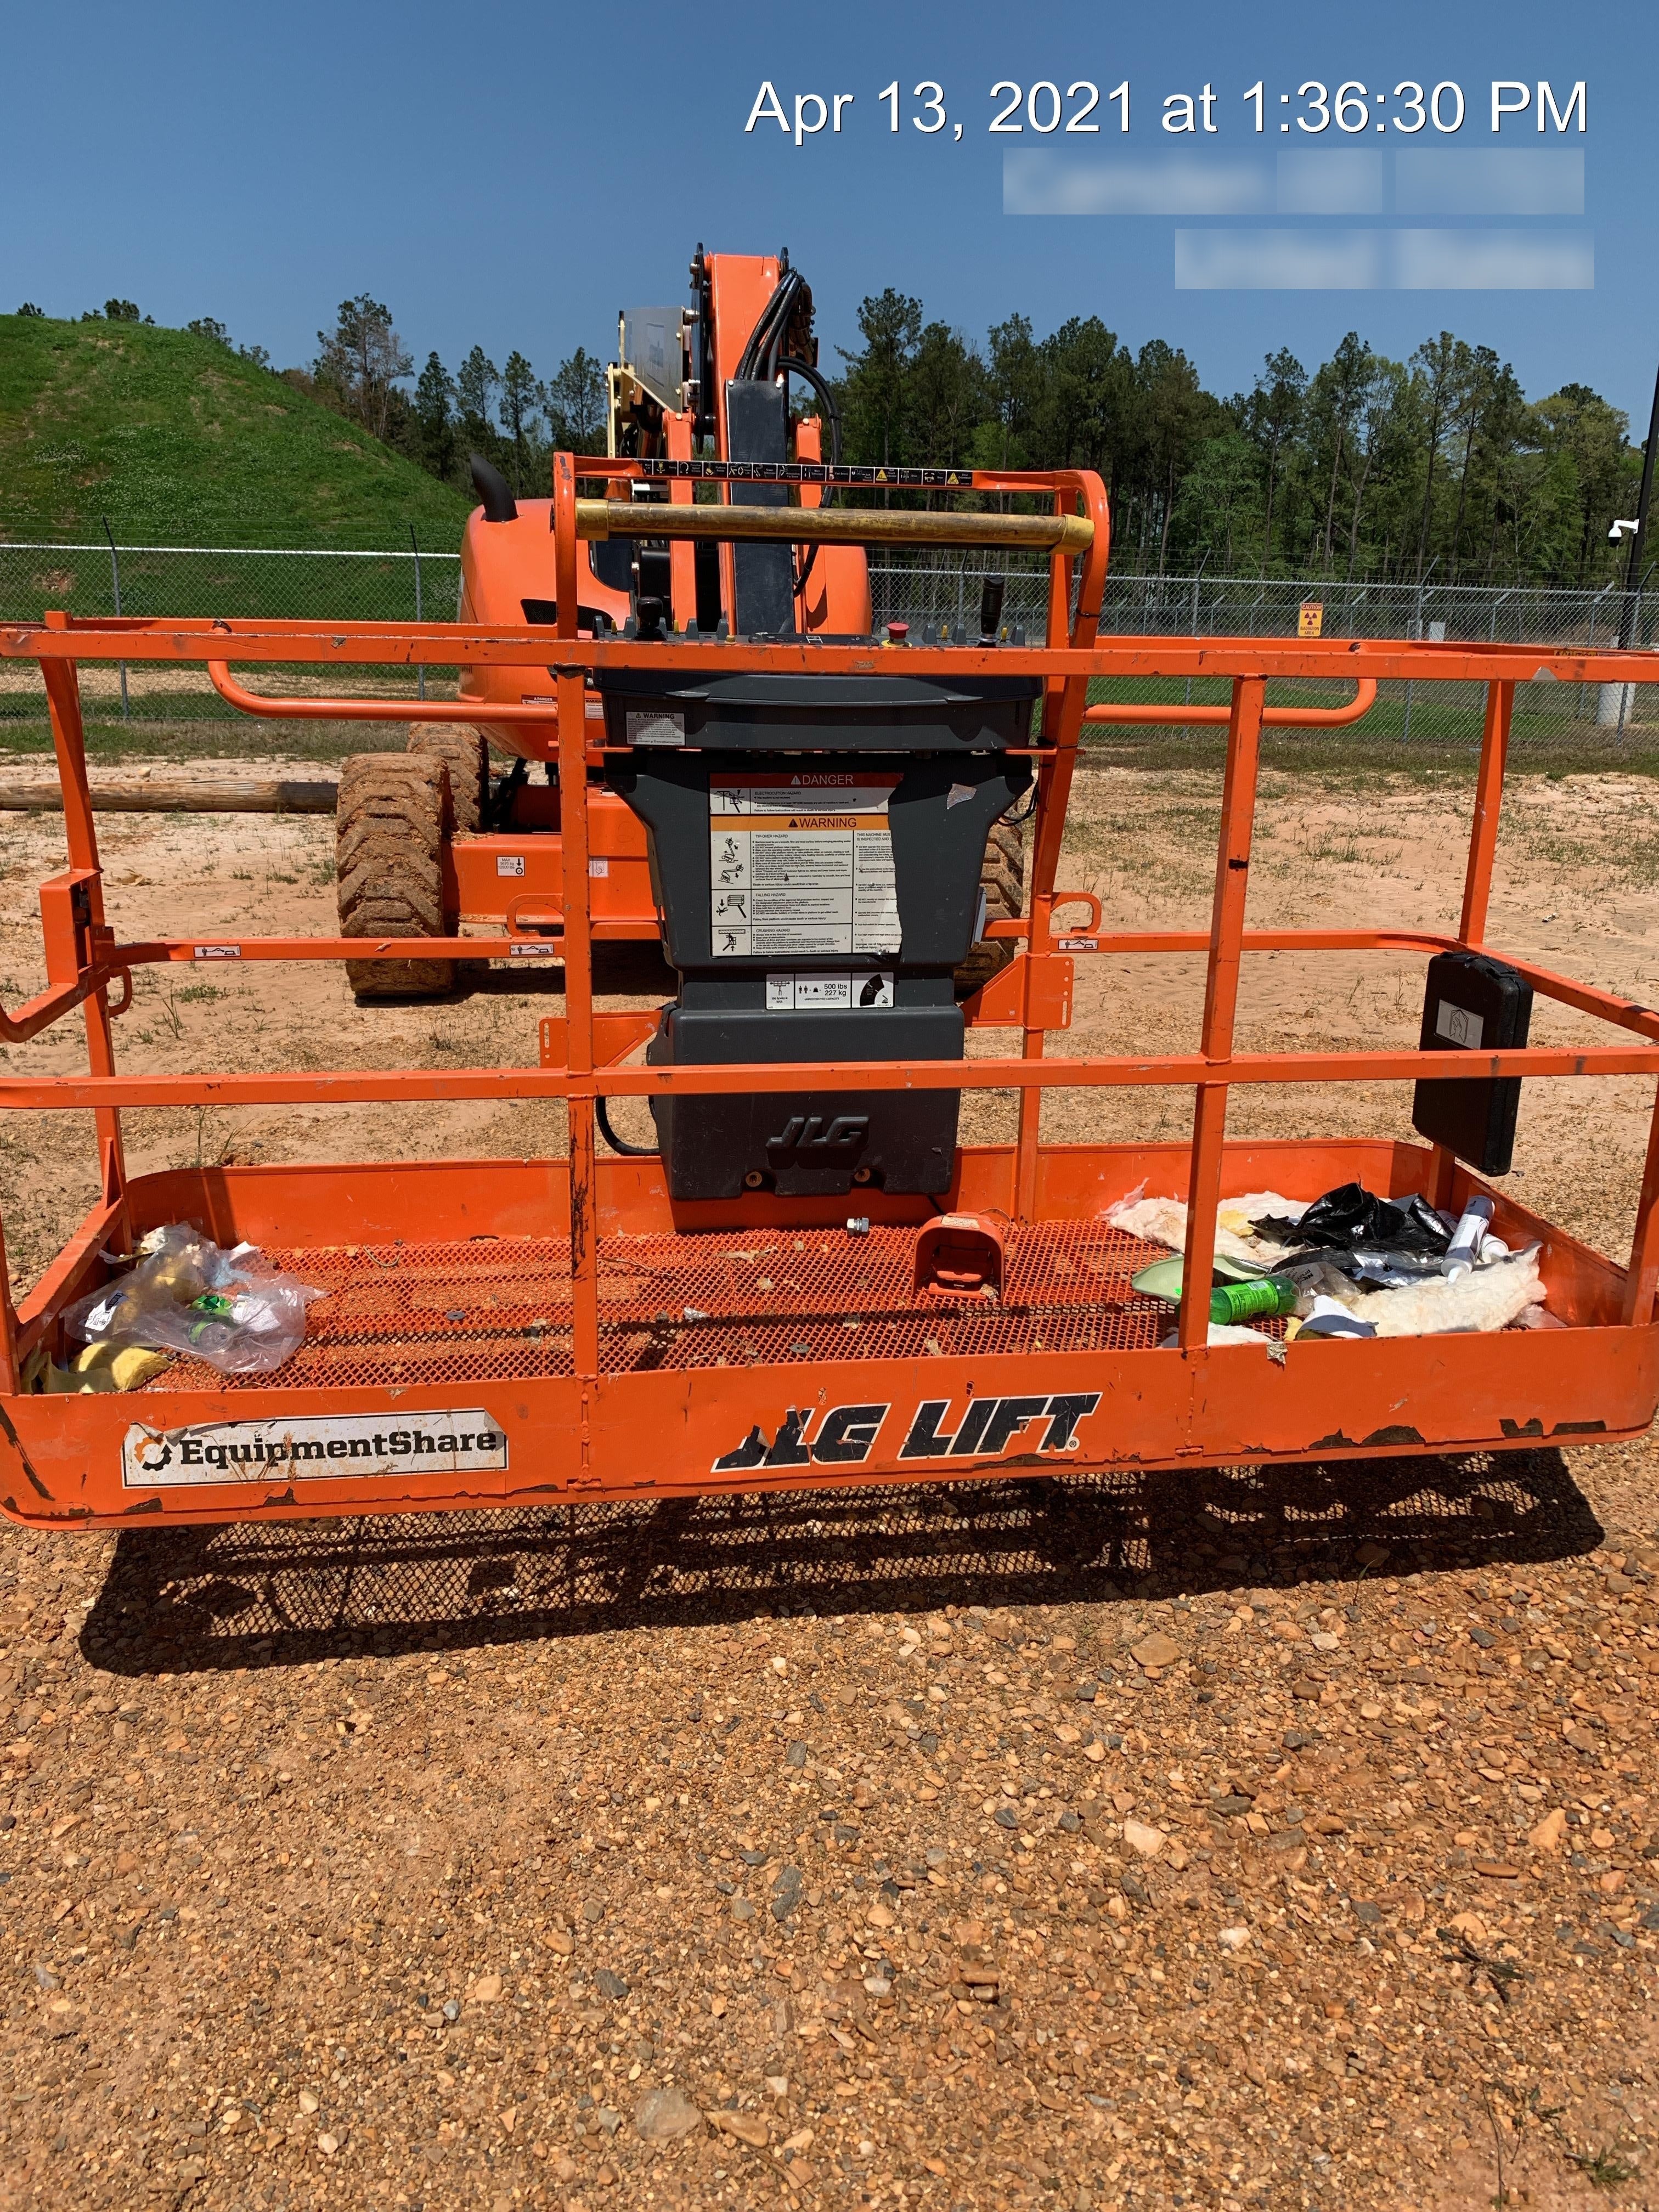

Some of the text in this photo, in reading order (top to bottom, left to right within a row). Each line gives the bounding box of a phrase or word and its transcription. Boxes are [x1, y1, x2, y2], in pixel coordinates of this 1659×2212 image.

[803, 775, 854, 785] DANGER
[799, 817, 856, 828] WARNING
[765, 1116, 870, 1148] JLG
[711, 1392, 1103, 1472] JLG LIFT
[180, 1430, 496, 1469] EquipmentShare
